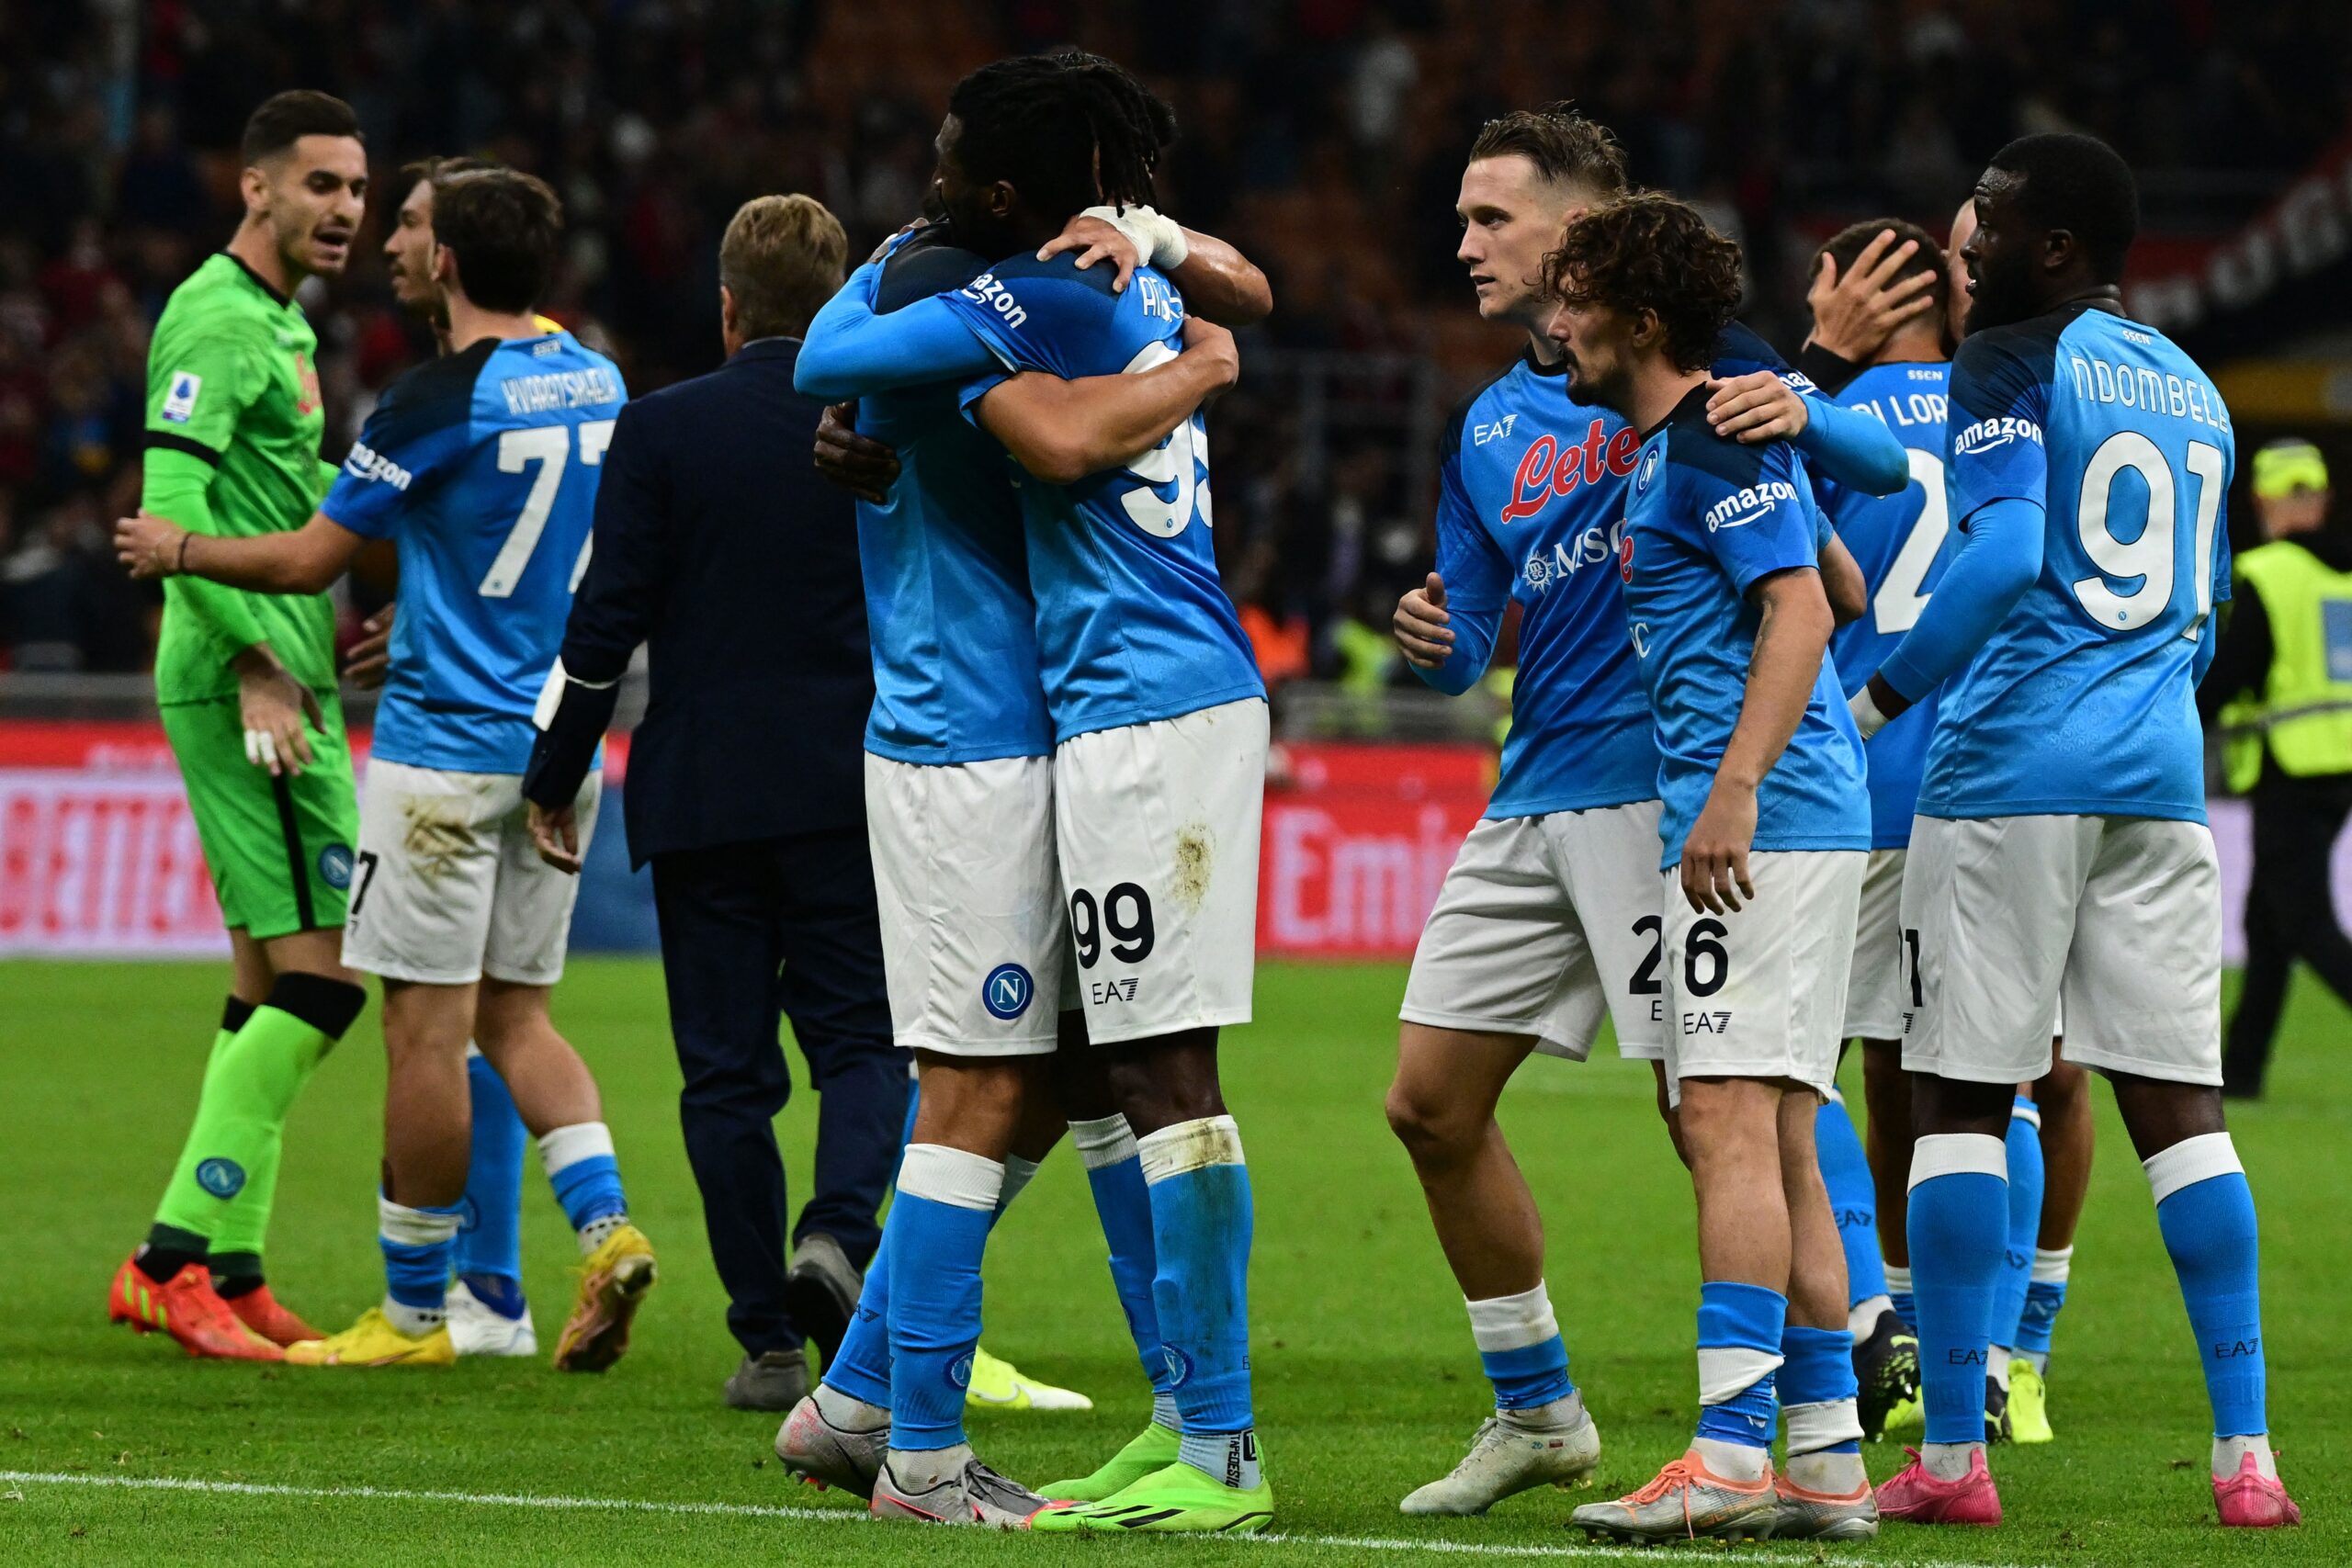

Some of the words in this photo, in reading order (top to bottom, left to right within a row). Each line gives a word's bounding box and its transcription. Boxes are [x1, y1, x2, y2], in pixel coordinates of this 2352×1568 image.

[970, 274, 1027, 329] azon
[2121, 330, 2151, 345] SSCN
[1907, 369, 1943, 381] SSCN
[1474, 413, 1519, 446] EA7
[1954, 417, 2043, 456] amazon
[1500, 418, 1642, 525] Lete
[1705, 481, 1799, 533] amazon
[2072, 430, 2223, 642] 91
[1070, 882, 1155, 969] 99
[1684, 918, 1729, 998] 6
[997, 978, 1020, 1004] N
[1091, 977, 1139, 1005] EA7
[1683, 1011, 1733, 1034] EA7
[2215, 1337, 2258, 1359] EA7
